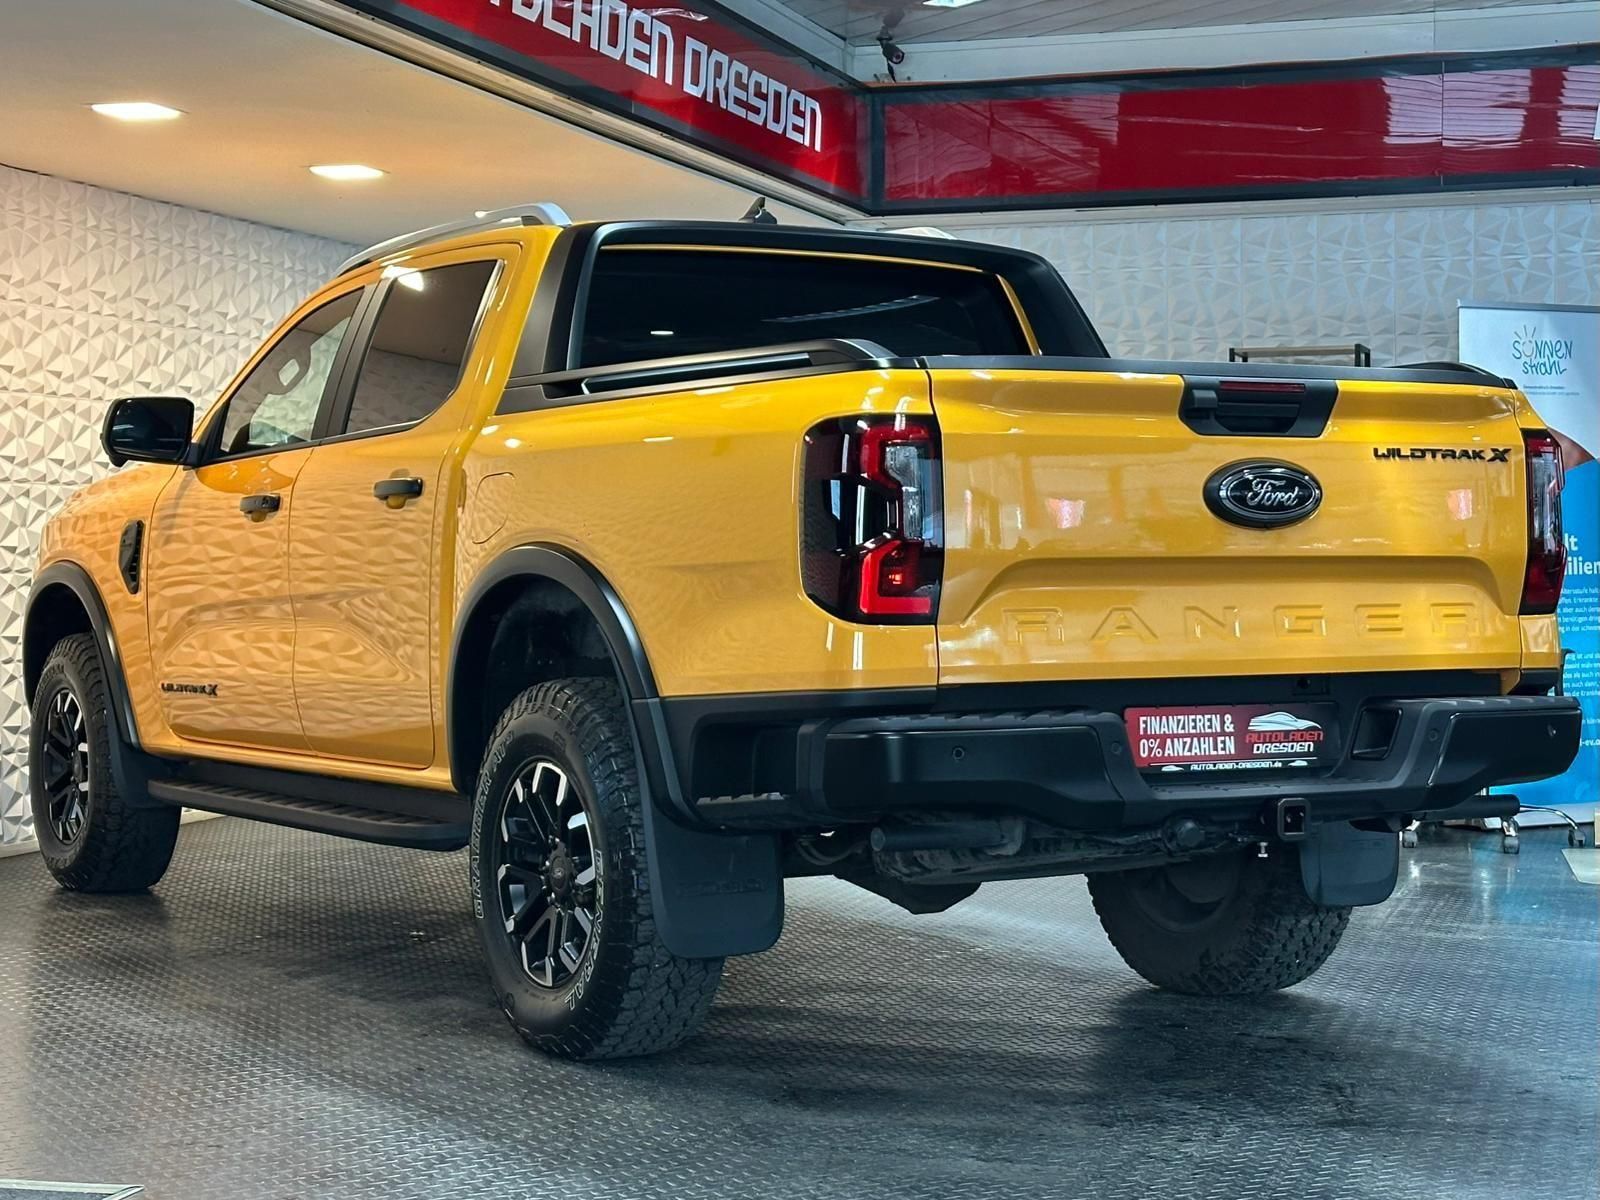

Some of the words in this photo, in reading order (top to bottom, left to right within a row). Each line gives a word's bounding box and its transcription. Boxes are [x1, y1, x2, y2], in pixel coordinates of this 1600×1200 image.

[490, 0, 676, 86] LADEN
[683, 36, 822, 152] DRESDEN
[1373, 447, 1486, 460] WILDTRAK
[1487, 447, 1512, 462] X
[1246, 477, 1299, 507] Ford
[1001, 604, 1480, 645] RANGER
[1139, 714, 1221, 735] FINANZIEREN
[1224, 713, 1235, 732] &
[1139, 738, 1162, 758] 0%
[1164, 736, 1235, 757] ANZAHLEN
[1245, 730, 1324, 744] AUTOLADEN
[1253, 741, 1314, 754] DRESDEN
